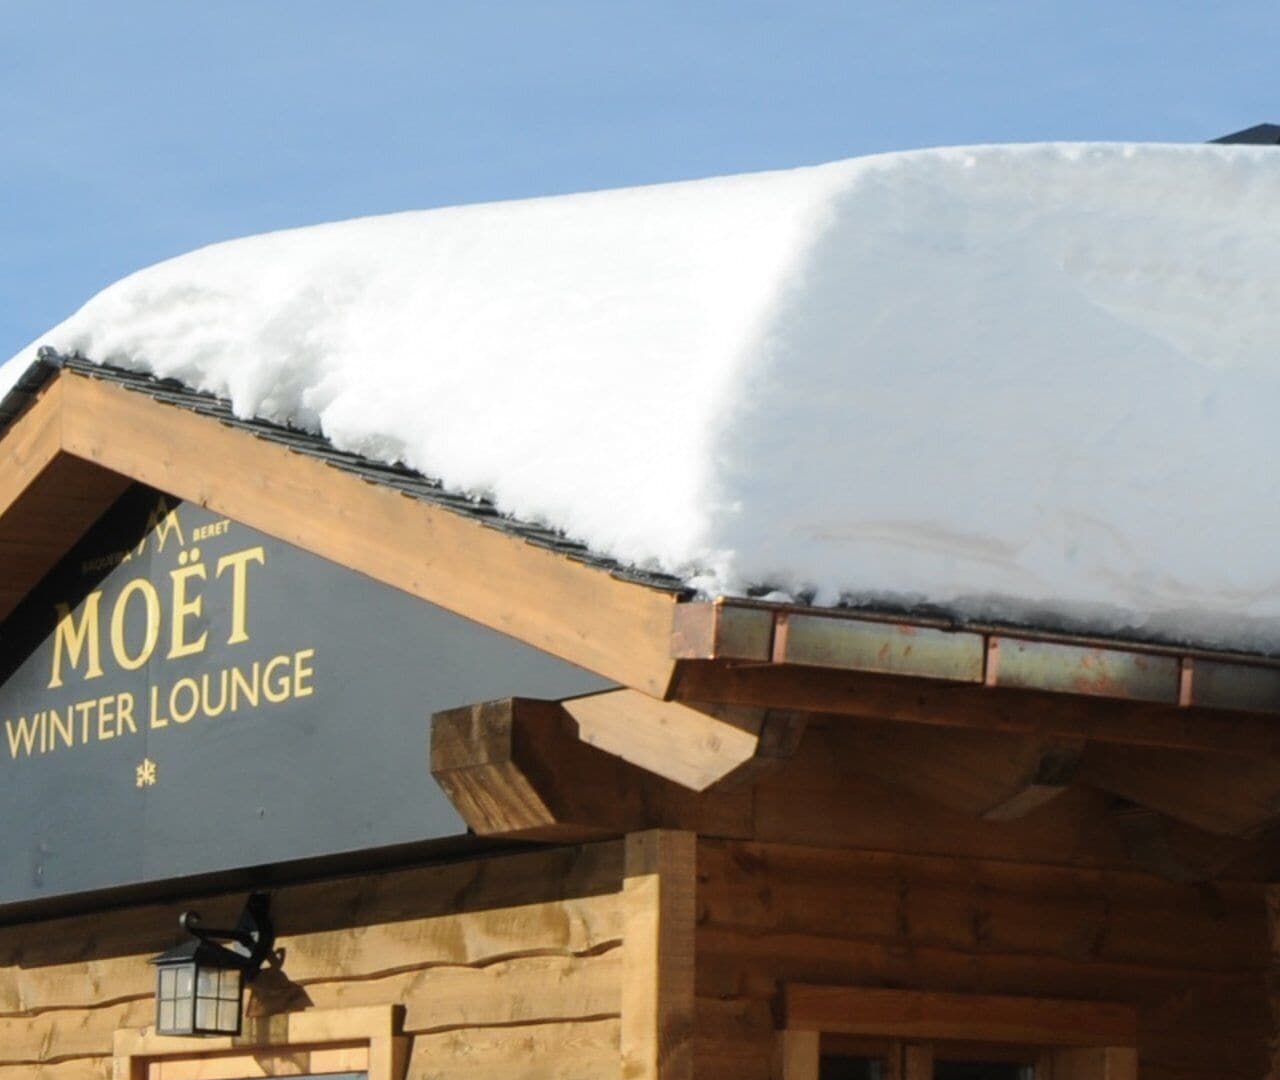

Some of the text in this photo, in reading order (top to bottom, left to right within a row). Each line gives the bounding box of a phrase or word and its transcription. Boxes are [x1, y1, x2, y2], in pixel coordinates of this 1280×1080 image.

[192, 519, 231, 542] BERET
[47, 546, 265, 689] MOËT
[6, 649, 315, 760] WINTER LOUNGE
